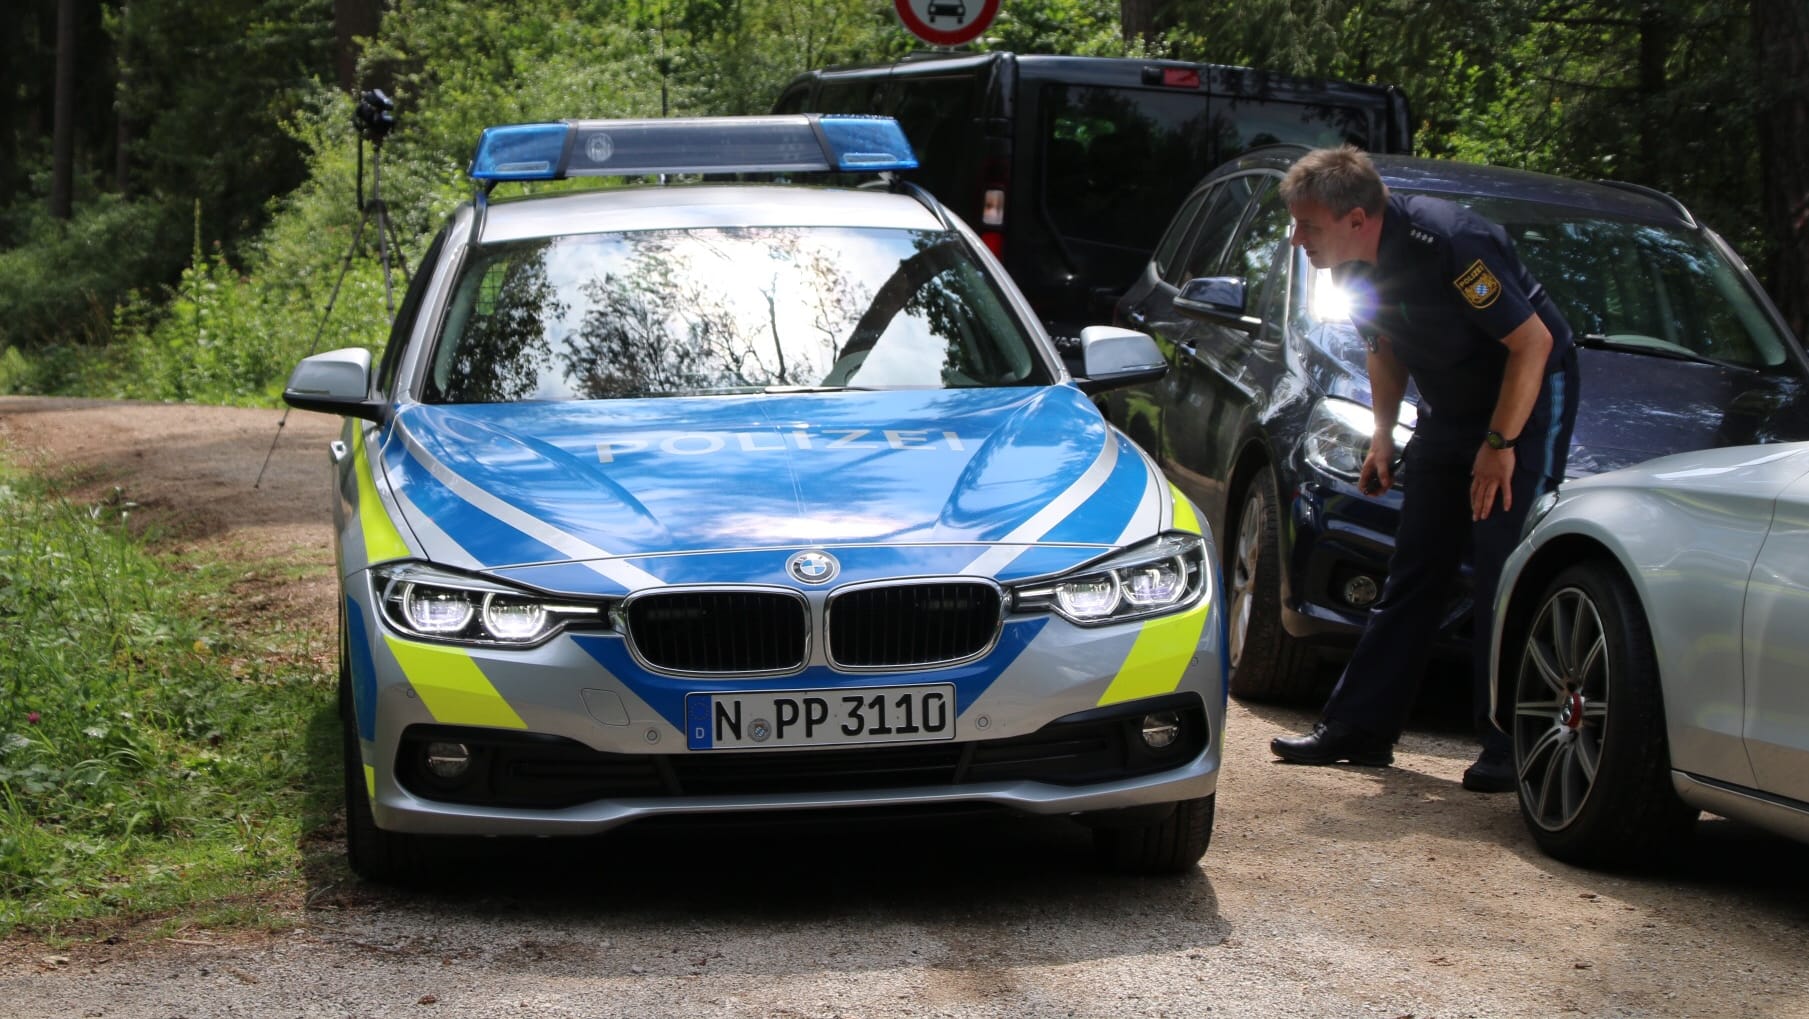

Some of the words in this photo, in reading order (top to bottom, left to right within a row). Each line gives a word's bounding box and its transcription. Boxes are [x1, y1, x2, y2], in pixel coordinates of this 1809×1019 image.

[1459, 264, 1484, 287] POLIZEI
[595, 429, 965, 463] POLIZEI
[715, 700, 742, 741] N
[774, 698, 828, 739] PP
[841, 692, 946, 737] 3110
[695, 727, 705, 739] D
